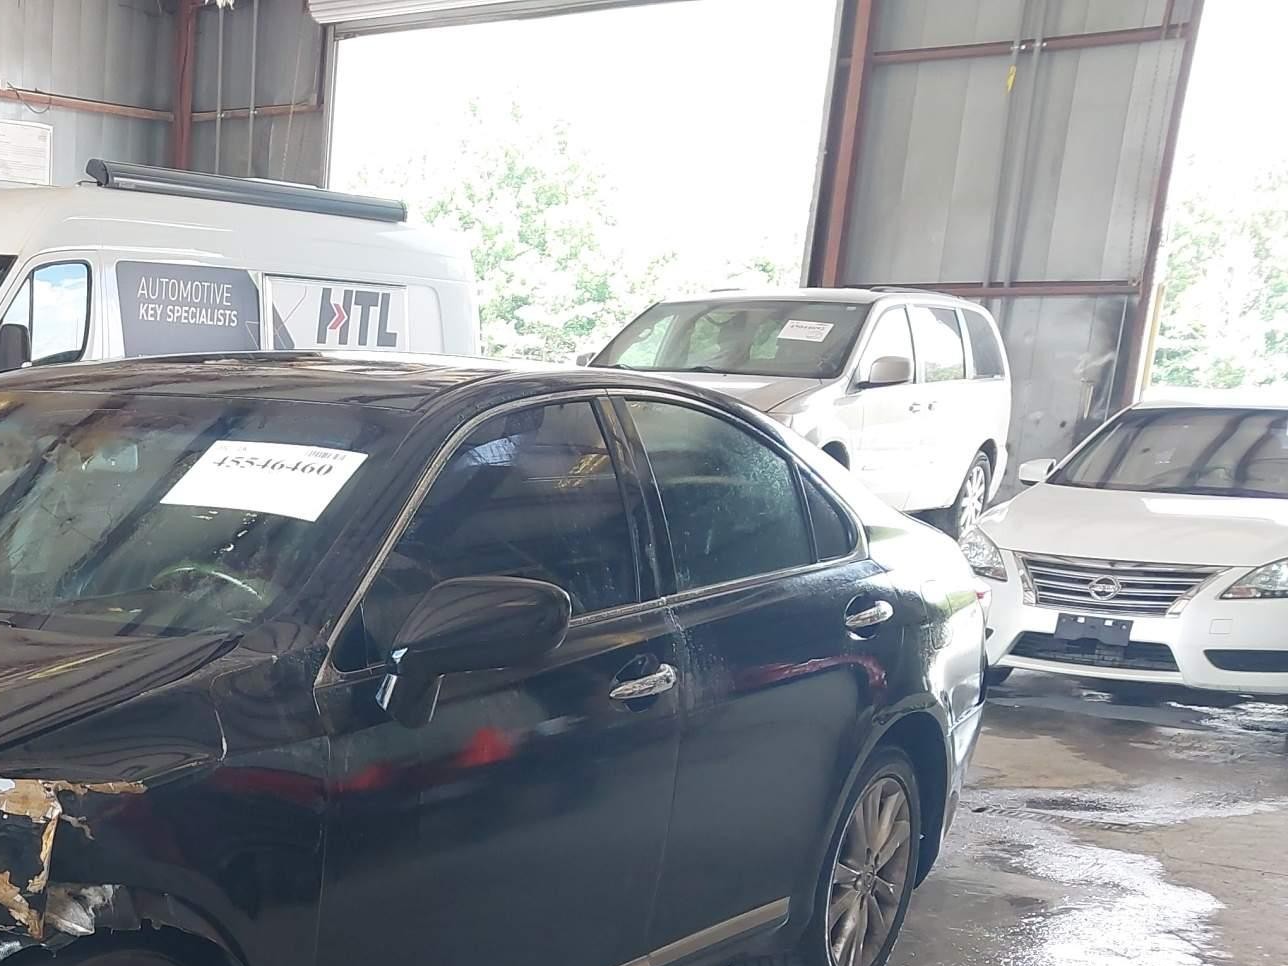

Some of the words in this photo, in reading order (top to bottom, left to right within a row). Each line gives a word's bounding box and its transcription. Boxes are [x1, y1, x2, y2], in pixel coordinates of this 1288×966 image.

[137, 276, 232, 306] AUTOMOTIVE
[139, 303, 163, 321] KEY
[166, 305, 238, 327] SPECIALISTS
[316, 287, 398, 347] HTL
[213, 456, 334, 476] 45546460
